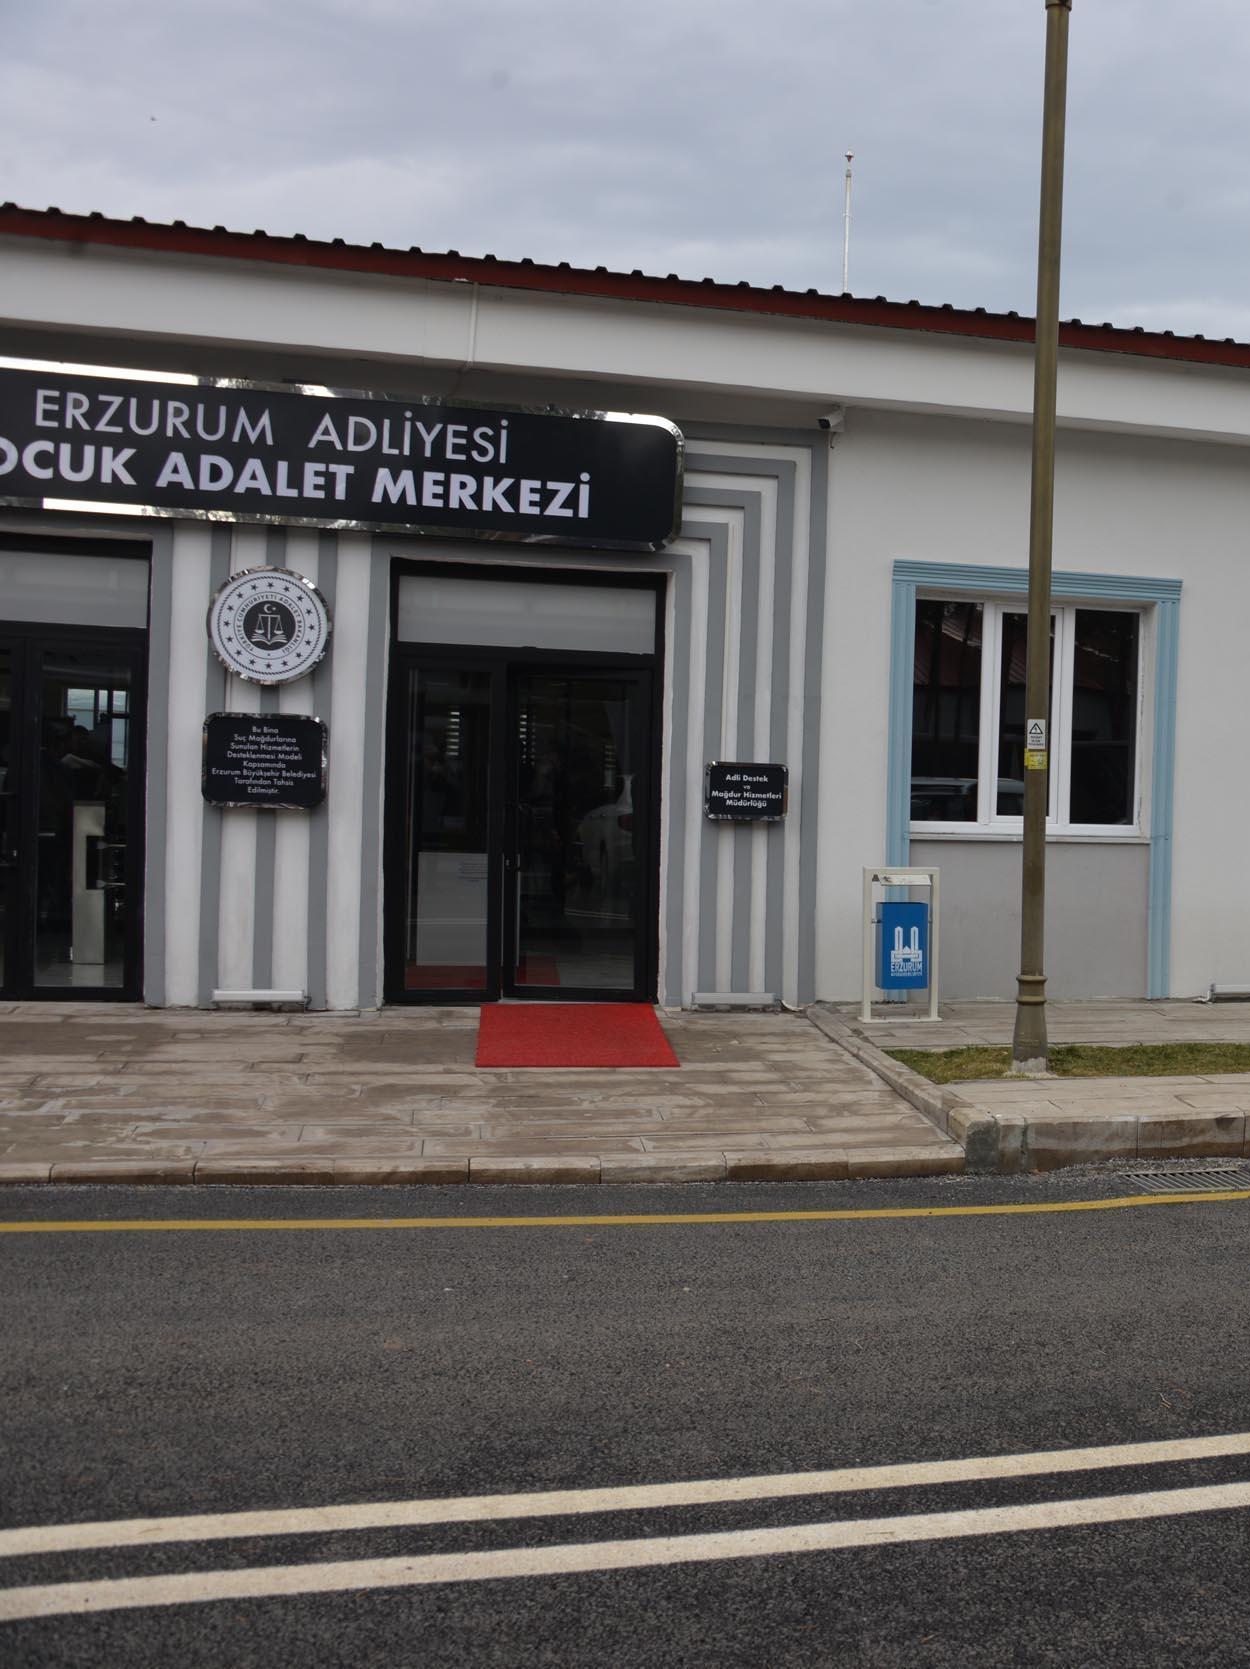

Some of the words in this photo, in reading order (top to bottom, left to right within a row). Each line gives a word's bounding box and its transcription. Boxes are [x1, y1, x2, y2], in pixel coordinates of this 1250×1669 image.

[35, 388, 274, 446] ERZURUM
[307, 410, 509, 464] ADLİYESİ
[155, 451, 355, 501] ADALET
[371, 471, 590, 519] MERKEZİ
[263, 726, 279, 734] Bina
[234, 734, 246, 742] Suç
[230, 742, 259, 750] Sunulan
[260, 743, 300, 751] Hizmetlerin
[227, 751, 276, 759] Desteklenmesi
[278, 752, 302, 760] Modeli
[282, 770, 317, 779] Belediyesi
[711, 790, 742, 799] Mağdur
[725, 799, 767, 808] Müdürlüğü
